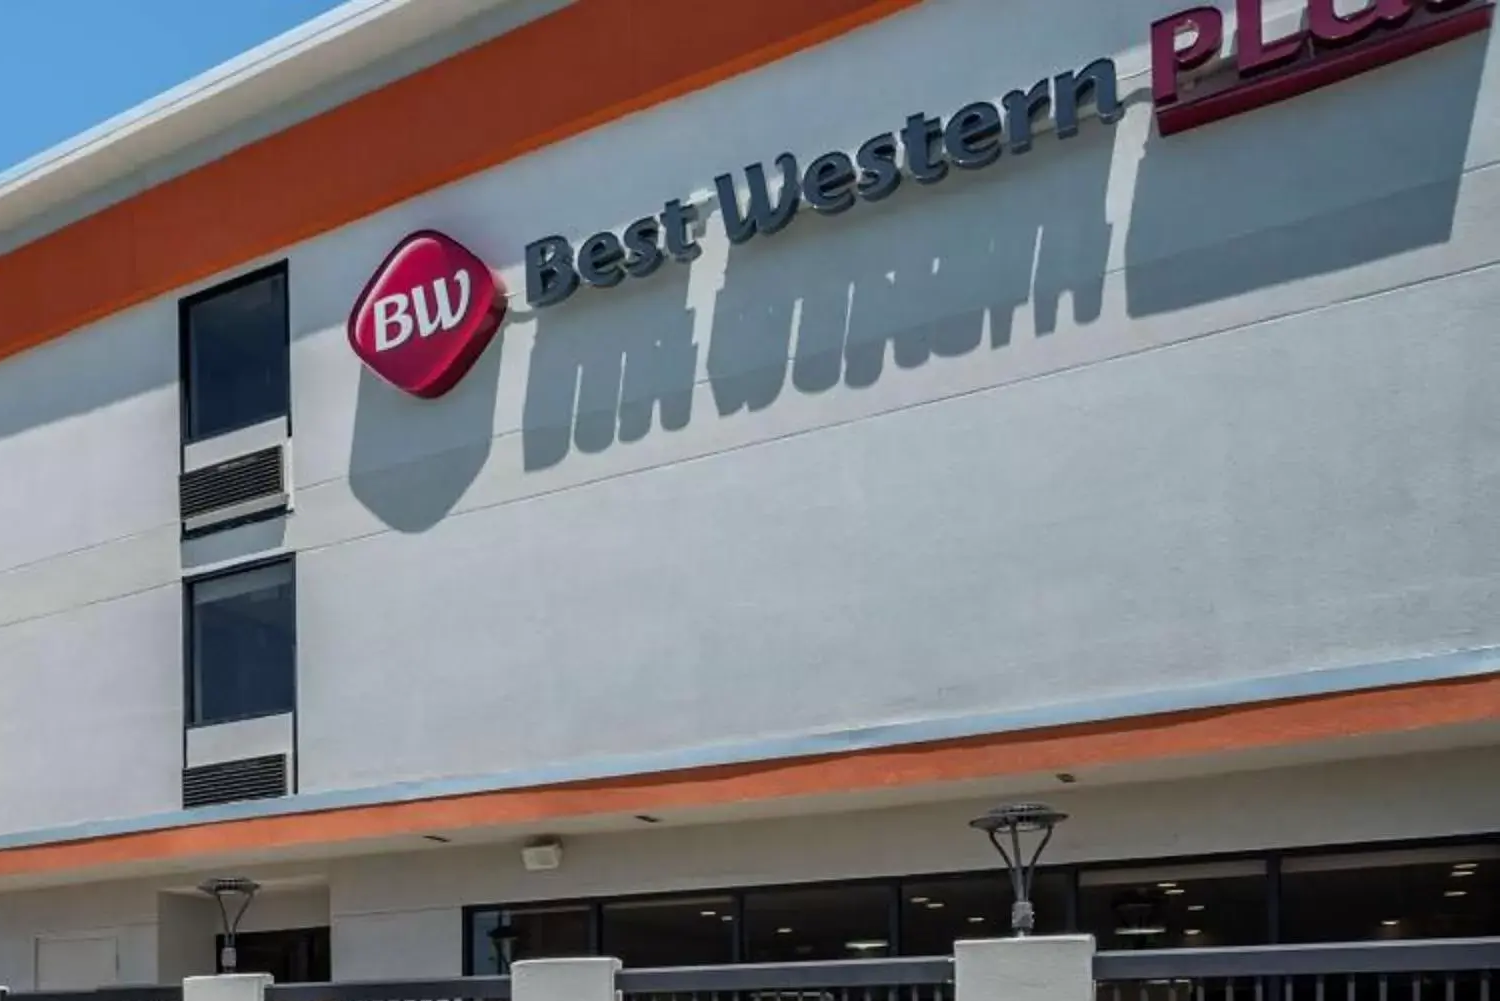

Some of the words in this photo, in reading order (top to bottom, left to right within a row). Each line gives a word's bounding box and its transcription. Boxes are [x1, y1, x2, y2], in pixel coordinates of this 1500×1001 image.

[524, 198, 701, 306] Best
[713, 57, 1124, 244] Western
[373, 268, 471, 352] BW
